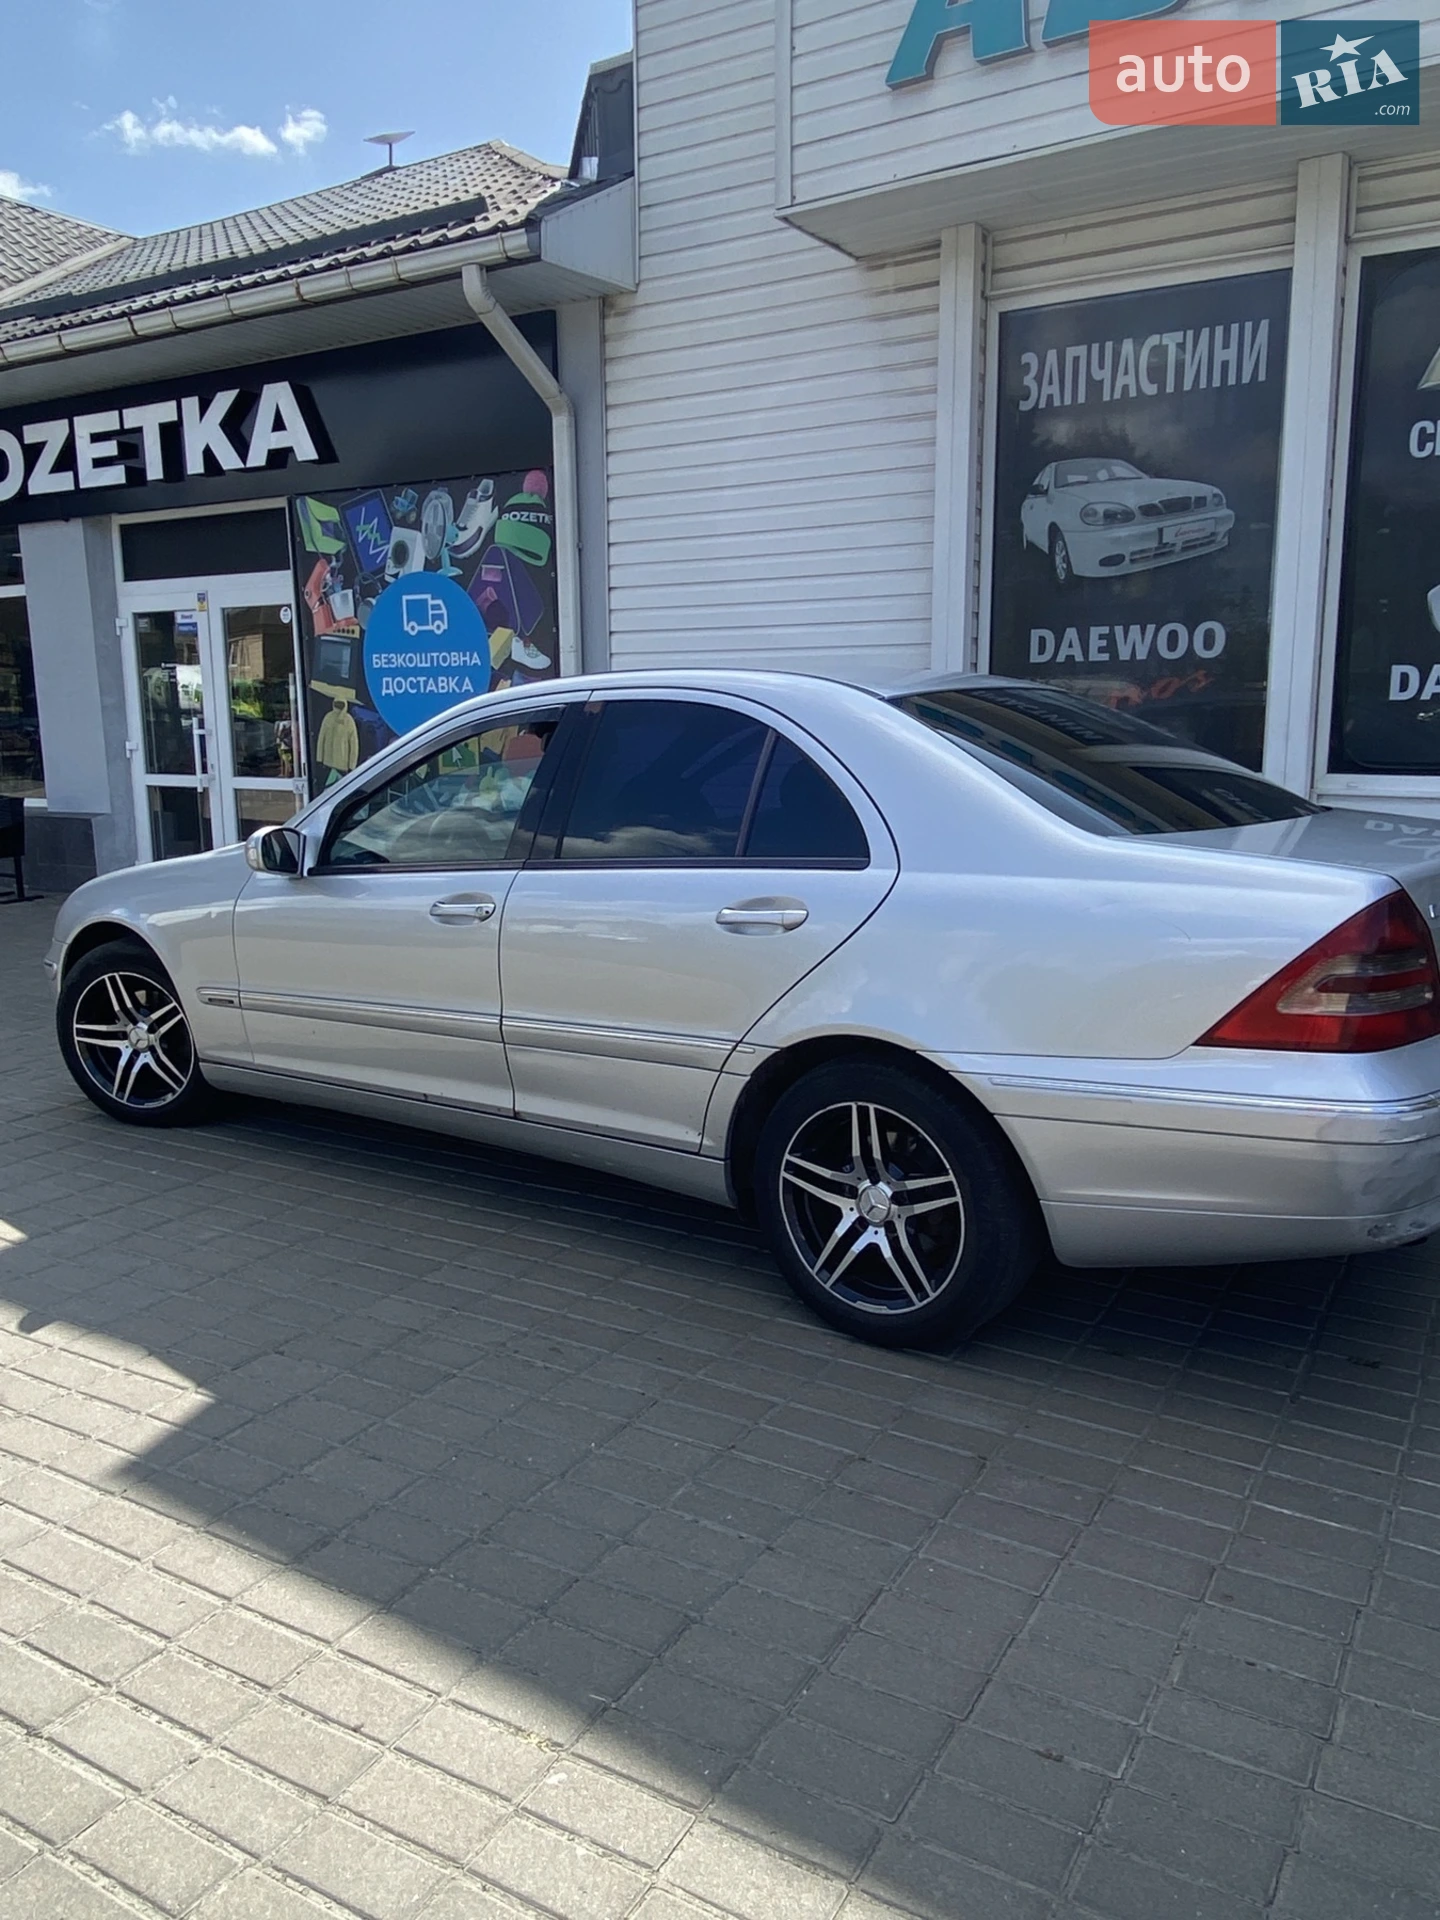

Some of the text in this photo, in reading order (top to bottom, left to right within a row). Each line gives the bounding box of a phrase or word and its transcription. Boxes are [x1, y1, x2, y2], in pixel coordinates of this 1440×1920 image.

[1018, 319, 1270, 412] ЗАПЧАСТИНИ
[1408, 419, 1440, 458] C
[372, 651, 481, 668] БЕЗКОШТОВНА
[1029, 620, 1227, 664] DAEWOO
[381, 676, 474, 697] ДОСТАВКА
